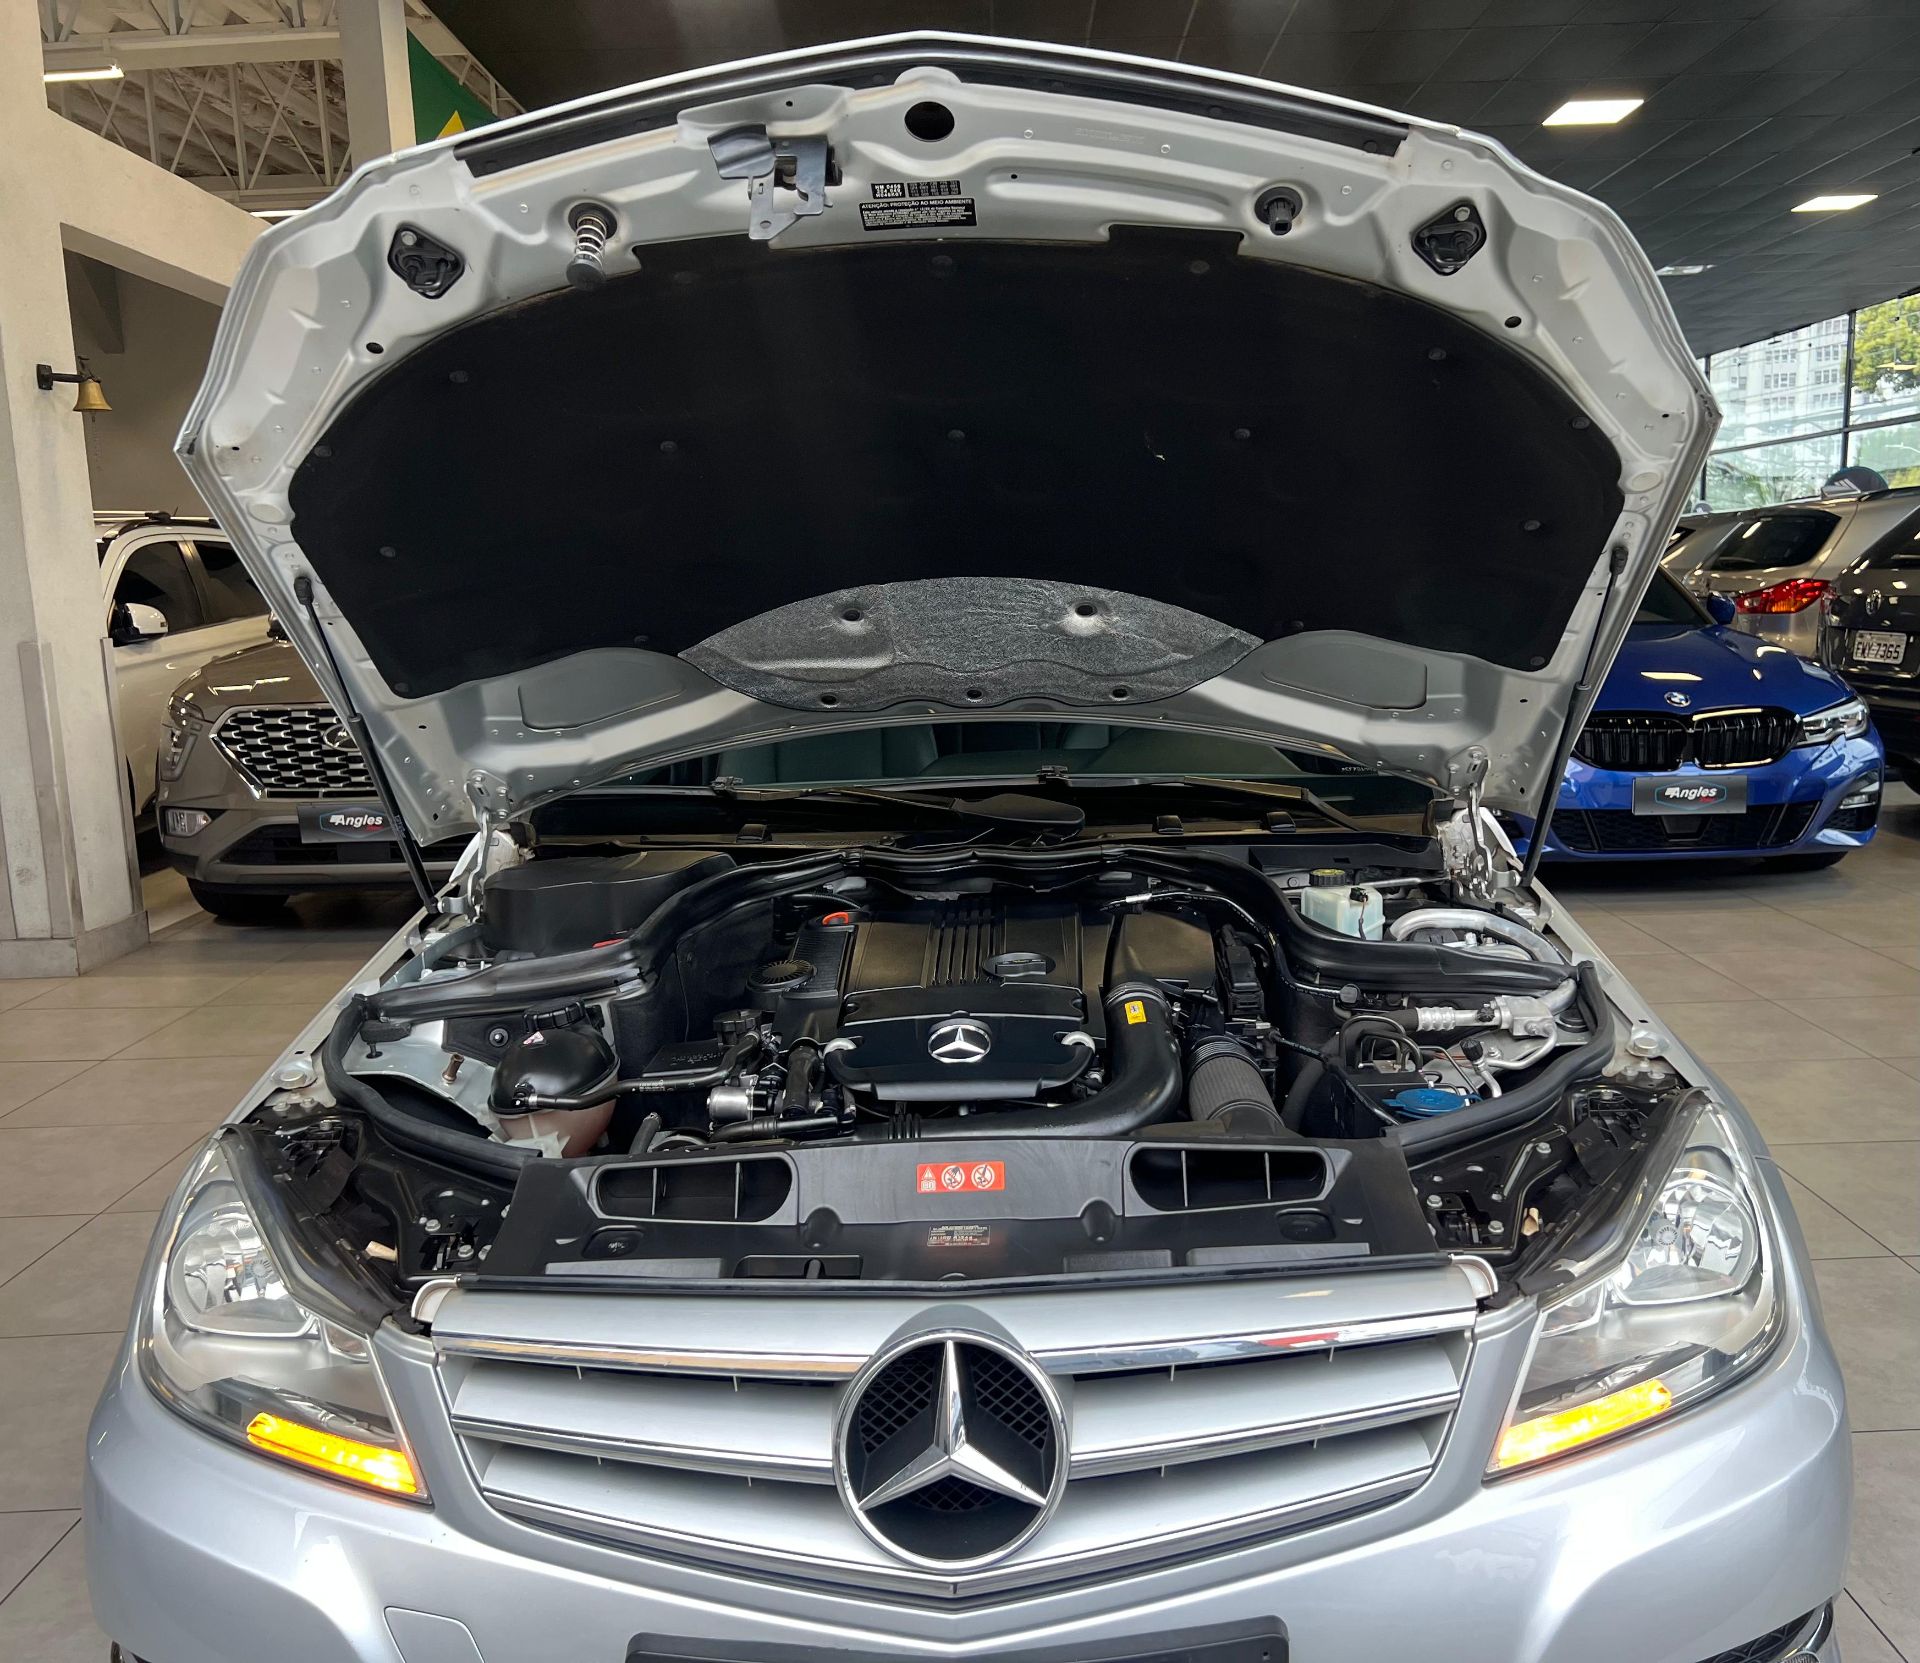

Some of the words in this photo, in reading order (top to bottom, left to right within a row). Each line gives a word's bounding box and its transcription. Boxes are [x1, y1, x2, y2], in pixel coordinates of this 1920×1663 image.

[890, 200, 919, 208] PROTEÇÃO
[1667, 786, 1717, 800] Angles
[332, 814, 383, 828] Angles
